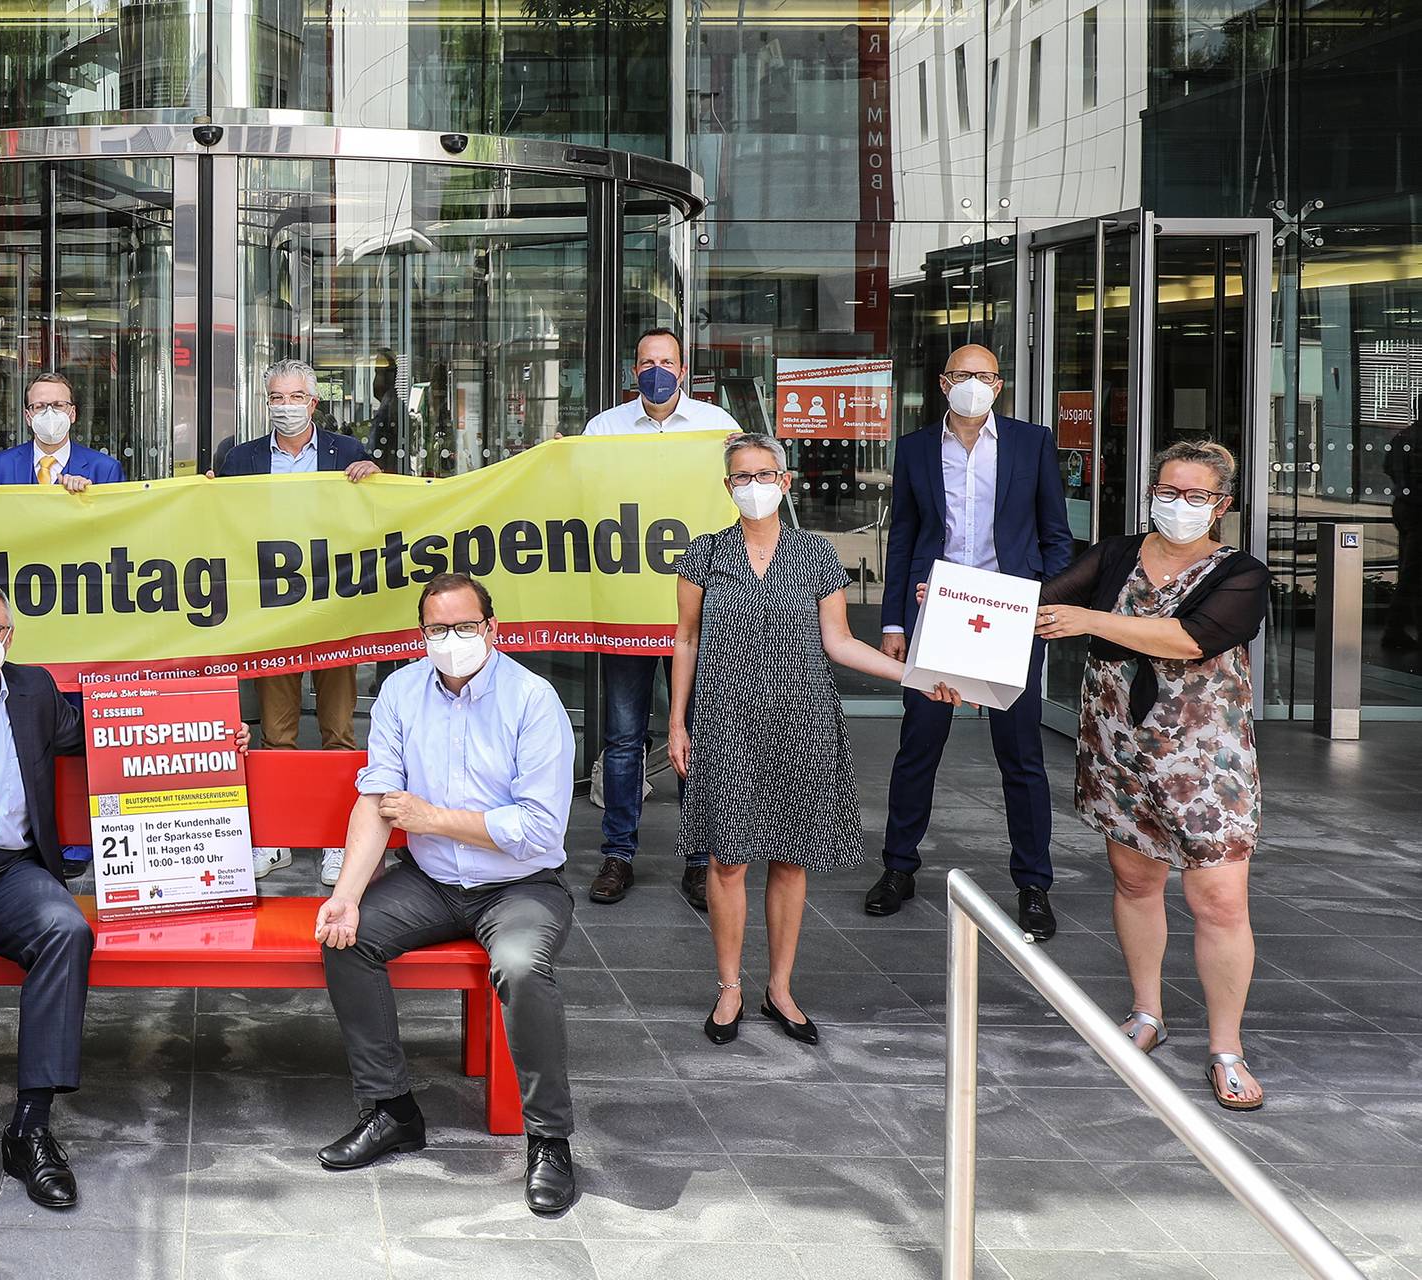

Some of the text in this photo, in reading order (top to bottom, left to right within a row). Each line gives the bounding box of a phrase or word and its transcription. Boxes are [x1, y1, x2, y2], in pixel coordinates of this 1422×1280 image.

[256, 503, 691, 608] Blutspende
[938, 587, 1029, 613] Blutkonserven
[78, 672, 111, 684] Infos
[115, 672, 139, 682] und
[143, 668, 200, 681] Termine:
[204, 663, 238, 675] 0800
[92, 707, 143, 718] 3. ESSENER
[93, 720, 234, 748] BLUTSPENDE-
[122, 751, 237, 777] MARATHON
[125, 796, 162, 805] BLUTSPENDE
[175, 791, 239, 801] TERMINRESERVIERUNG!
[101, 823, 134, 833] Montag
[145, 816, 231, 830] In der Kundenhalle
[146, 829, 243, 844] der Sparkasse Essen
[102, 836, 138, 859] 21.
[161, 846, 191, 857] Hagen
[193, 843, 205, 852] 43
[207, 854, 223, 863] Uhr
[102, 861, 134, 876] Juni
